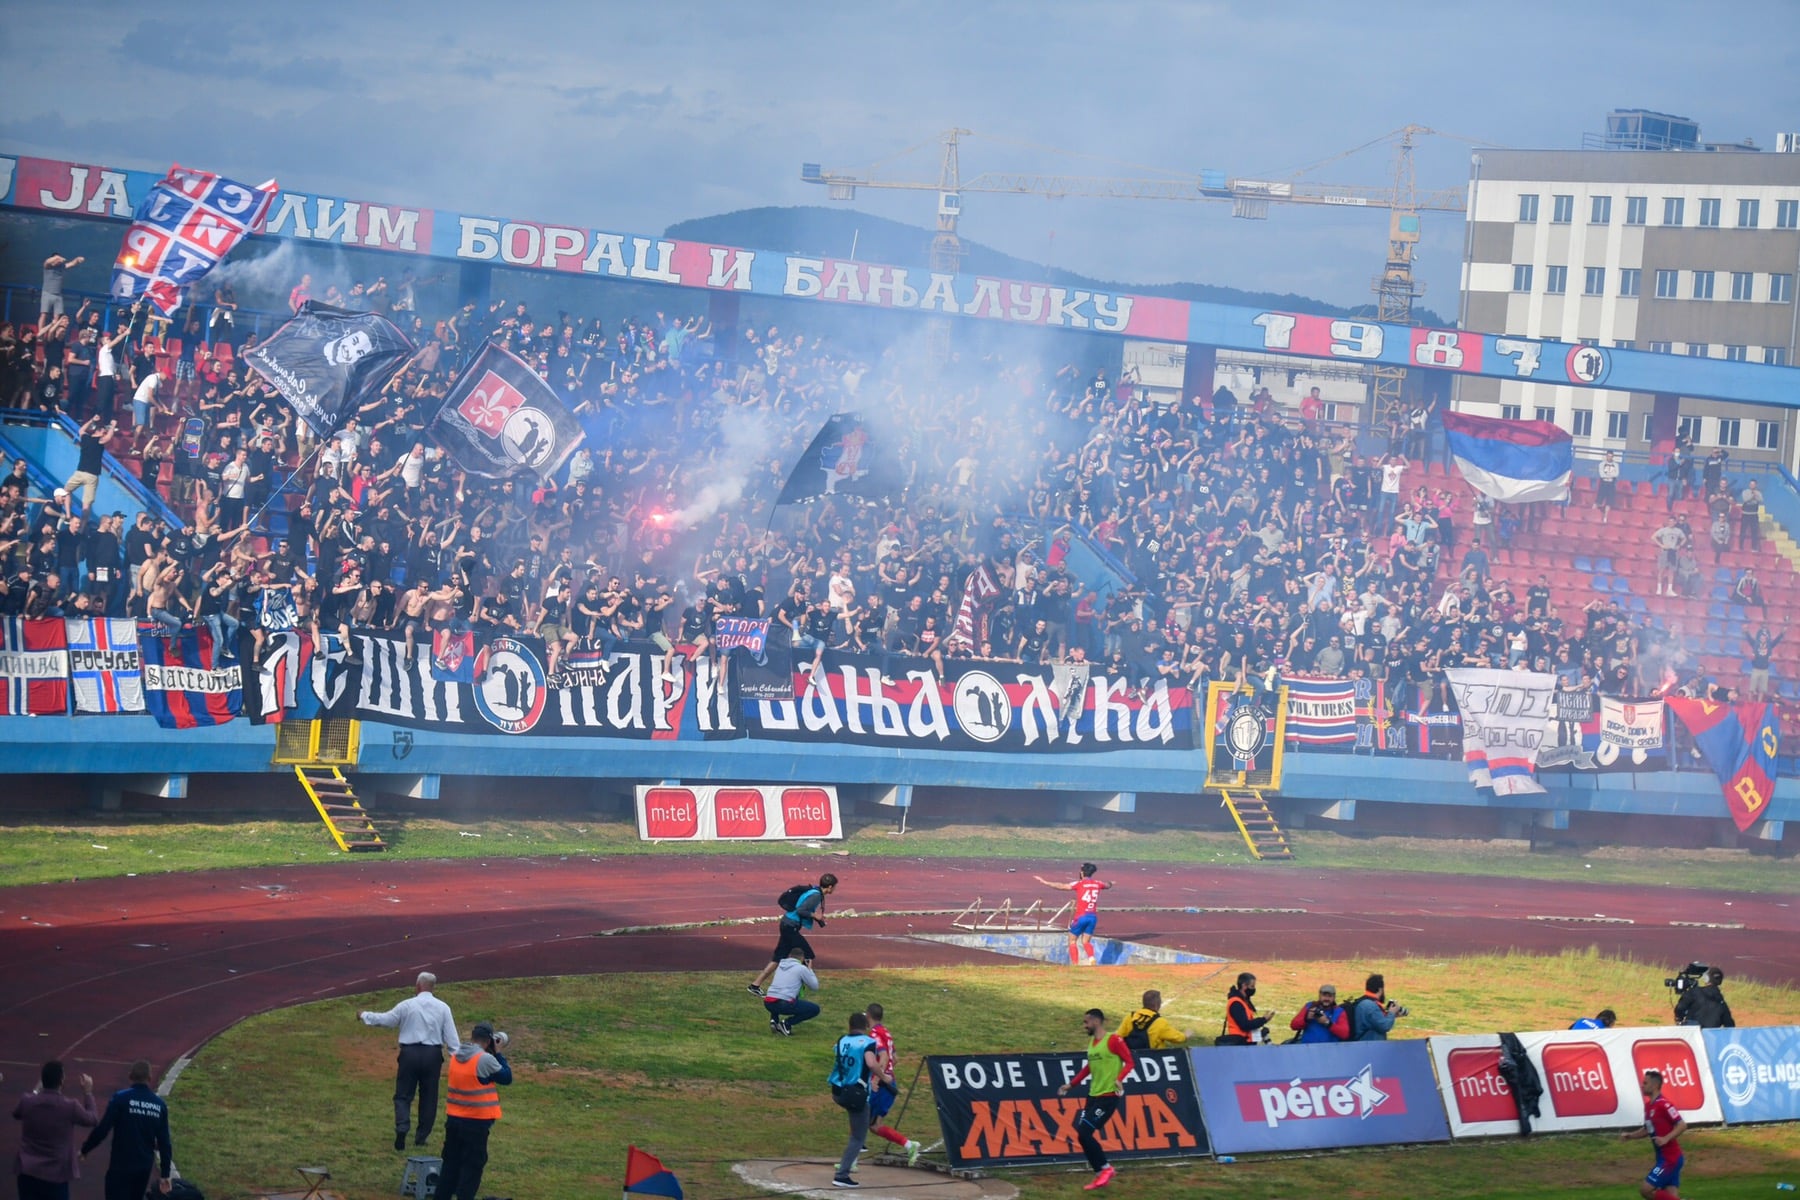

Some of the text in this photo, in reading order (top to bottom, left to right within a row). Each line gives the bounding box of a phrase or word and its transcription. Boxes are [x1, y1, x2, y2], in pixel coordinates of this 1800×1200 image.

[40, 166, 134, 217] ЈА
[253, 192, 420, 252] ЛИМ
[457, 215, 681, 284] БОРАЦ
[707, 247, 756, 291] И
[1253, 312, 1542, 377] 1987
[71, 650, 138, 671] РОСУЉЕ
[1287, 699, 1354, 717] VULTURES
[651, 803, 692, 822] m:tel
[720, 803, 761, 822] m:tel
[788, 803, 827, 821] m:tel
[1081, 889, 1099, 903] 45
[941, 1061, 1026, 1090] BOJE
[1037, 1060, 1049, 1087] I
[1459, 1070, 1511, 1098] m:te
[1553, 1062, 1609, 1093] m:tel
[141, 1101, 161, 1113] БОРАЦ
[1259, 1063, 1390, 1129] pérex
[960, 1093, 1198, 1160] MAXMA
